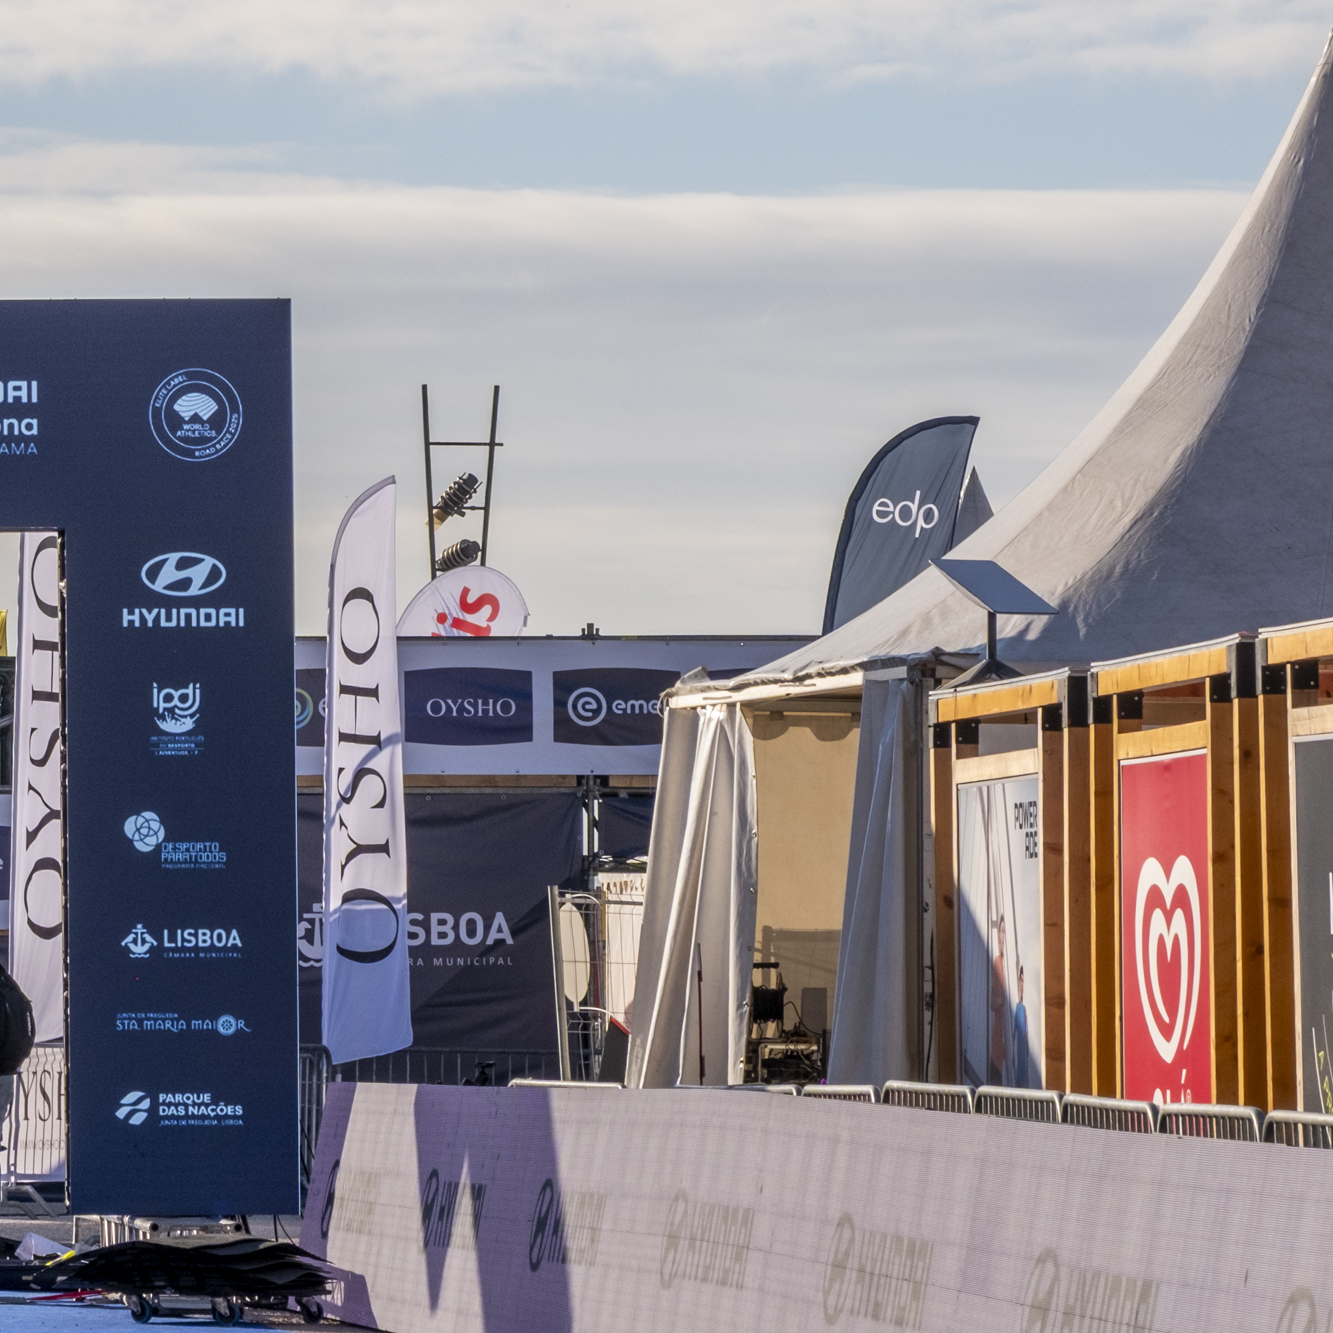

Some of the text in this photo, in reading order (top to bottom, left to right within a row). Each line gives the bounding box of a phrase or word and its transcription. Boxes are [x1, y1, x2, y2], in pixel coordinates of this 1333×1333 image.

[155, 374, 188, 407] ELITE LABEL
[194, 447, 216, 457] ROAD
[872, 490, 939, 538] edp
[123, 608, 244, 627] HYUNDAI
[153, 681, 200, 715] ipdj
[612, 700, 662, 714] eme
[426, 698, 516, 717] OYSHO
[336, 586, 399, 963] OYSHO
[1014, 800, 1038, 830] POWER
[161, 842, 219, 852] DESPORTO
[1025, 830, 1038, 860] ADE
[161, 852, 226, 863] PARATODOS
[406, 911, 514, 946] SBOA
[163, 929, 242, 947] LISBOA
[434, 957, 513, 966] MUNICIPAL
[143, 1020, 186, 1032] MARIA
[158, 1093, 211, 1104] PARQUE
[158, 1102, 243, 1117] DAS NAÇÕES
